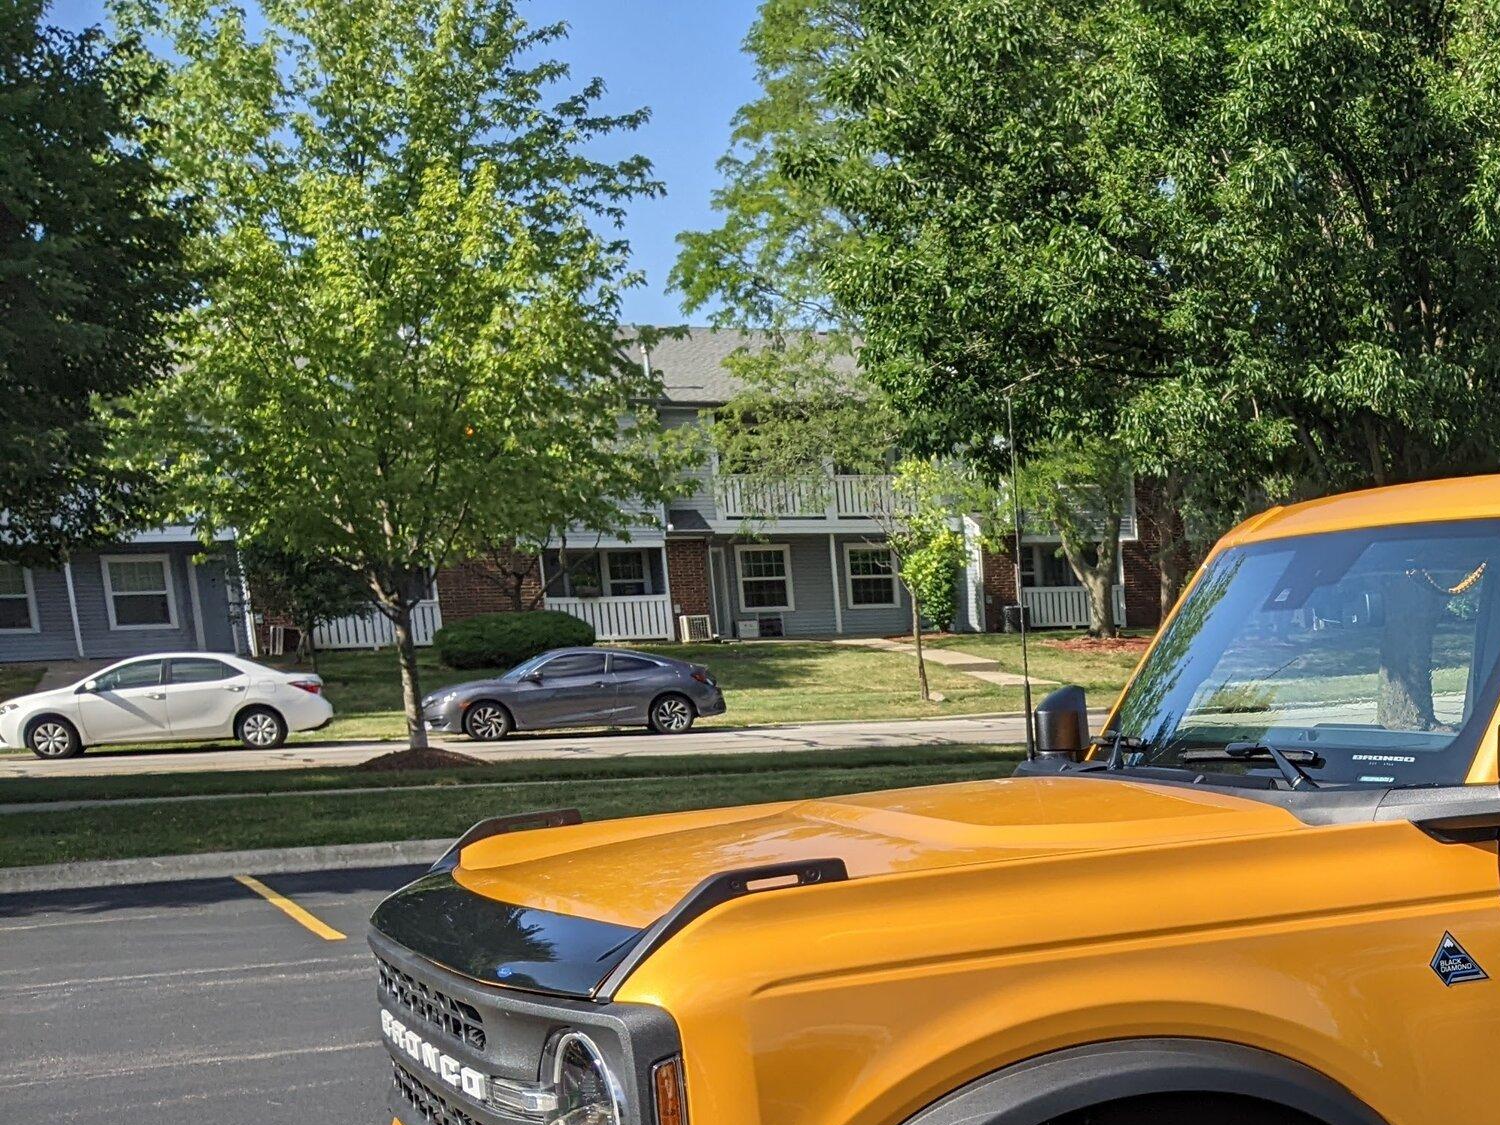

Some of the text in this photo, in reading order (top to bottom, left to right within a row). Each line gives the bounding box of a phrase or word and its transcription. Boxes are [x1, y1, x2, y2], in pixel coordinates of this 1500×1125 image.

[1352, 754, 1416, 763] BRONCO
[1439, 957, 1462, 967] BLACK
[1440, 962, 1472, 973] DIAMOND
[381, 1009, 487, 1101] BRONCO
